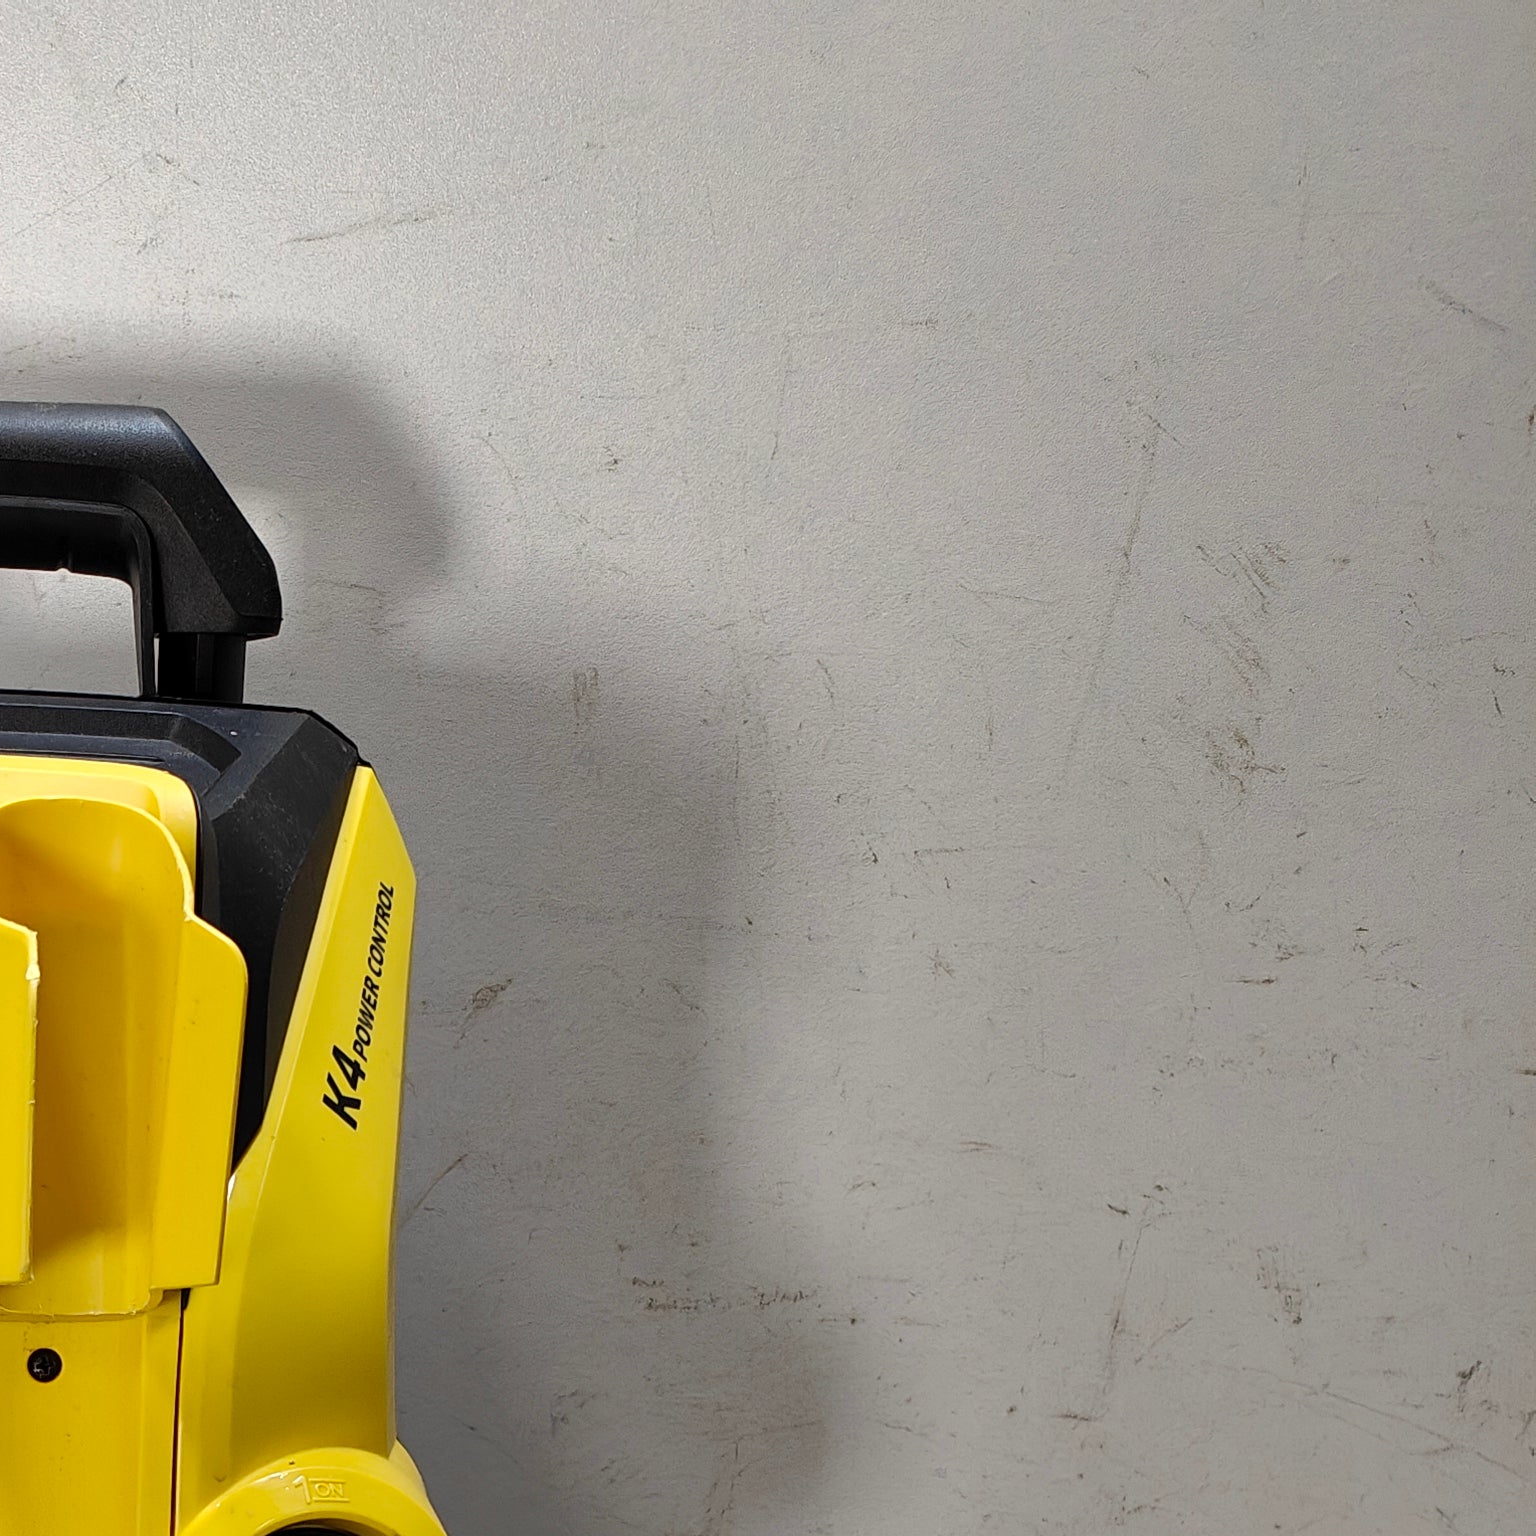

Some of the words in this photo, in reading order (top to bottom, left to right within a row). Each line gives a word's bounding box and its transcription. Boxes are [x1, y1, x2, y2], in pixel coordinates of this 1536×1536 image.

[321, 1045, 366, 1131] K4
[352, 975, 379, 1063] POWER
[367, 881, 395, 978] CONTROL
[314, 1482, 344, 1498] ON
